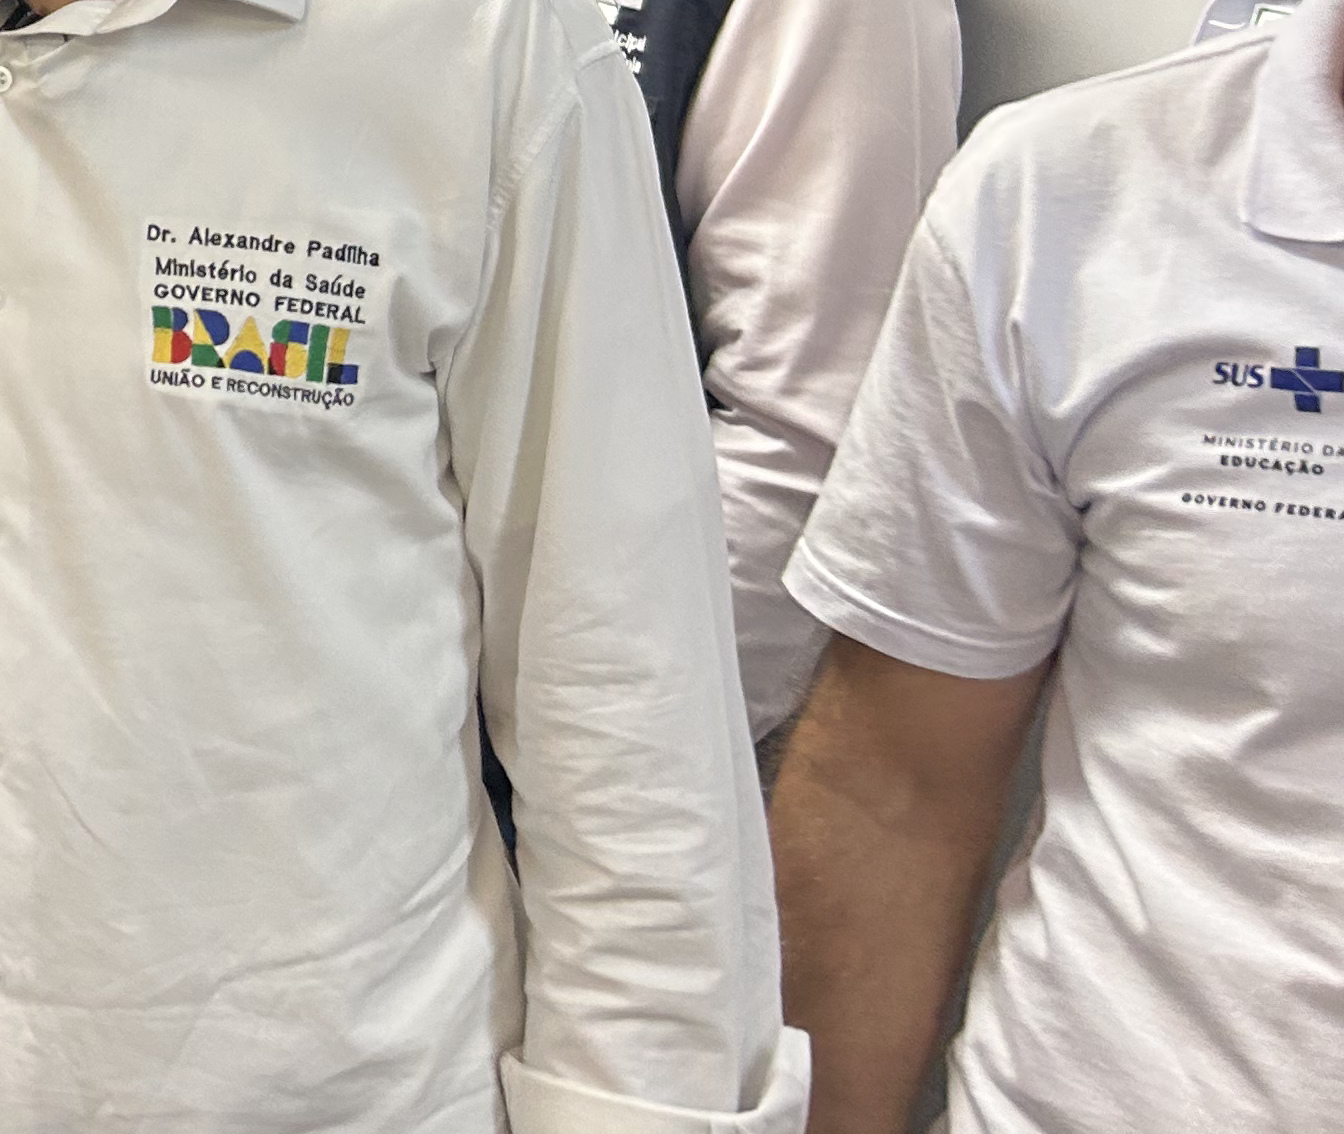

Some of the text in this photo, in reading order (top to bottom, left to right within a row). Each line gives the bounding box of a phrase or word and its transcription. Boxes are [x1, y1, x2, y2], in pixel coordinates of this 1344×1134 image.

[146, 224, 176, 243] Dr.
[188, 226, 295, 254] Alexandre
[155, 256, 366, 299] Ministério da Saúde
[153, 283, 366, 324] GOVERNO FEDERAL
[151, 305, 359, 385] BRASIL
[150, 368, 354, 410] UNIÃO E RECONSTRUÇÃO
[1213, 362, 1265, 388] SUS
[1203, 434, 1314, 454] MINISTÉRIO
[1220, 454, 1324, 475] EDUCAÇÃO
[1181, 492, 1266, 512] GOVERNO
